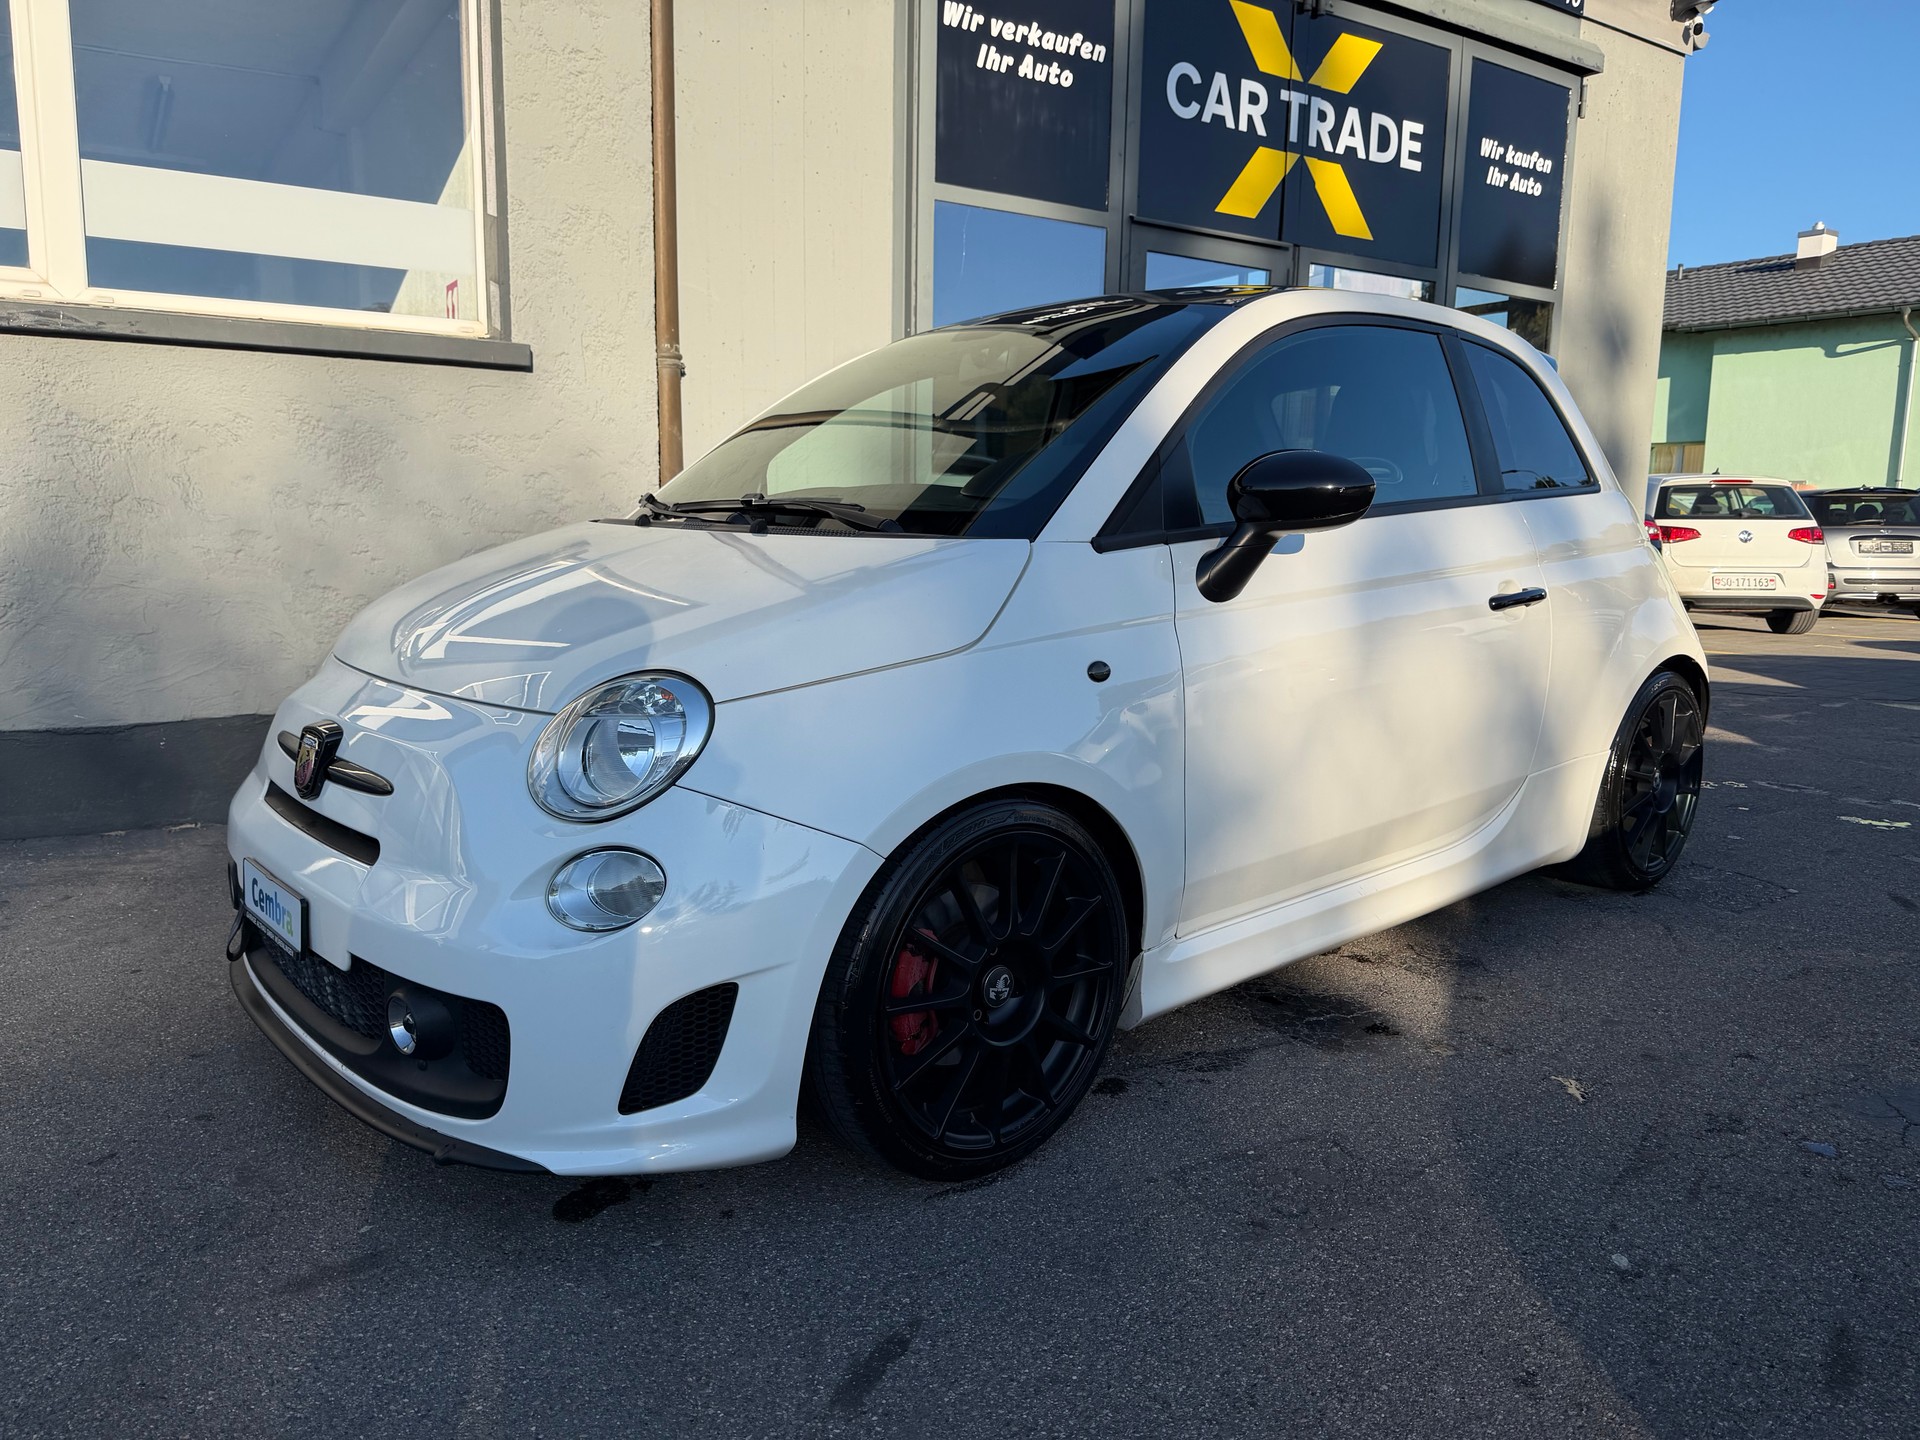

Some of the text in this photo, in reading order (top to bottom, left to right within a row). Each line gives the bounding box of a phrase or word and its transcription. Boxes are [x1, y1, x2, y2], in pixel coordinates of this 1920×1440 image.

[943, 0, 1107, 63] Wir verkaufen
[976, 43, 1074, 88] Ihr Auto
[1166, 61, 1425, 172] CAR TRADE
[1480, 137, 1553, 174] Wir kaufen
[1486, 166, 1543, 197] Ihr Auto
[251, 877, 294, 937] Cembra
